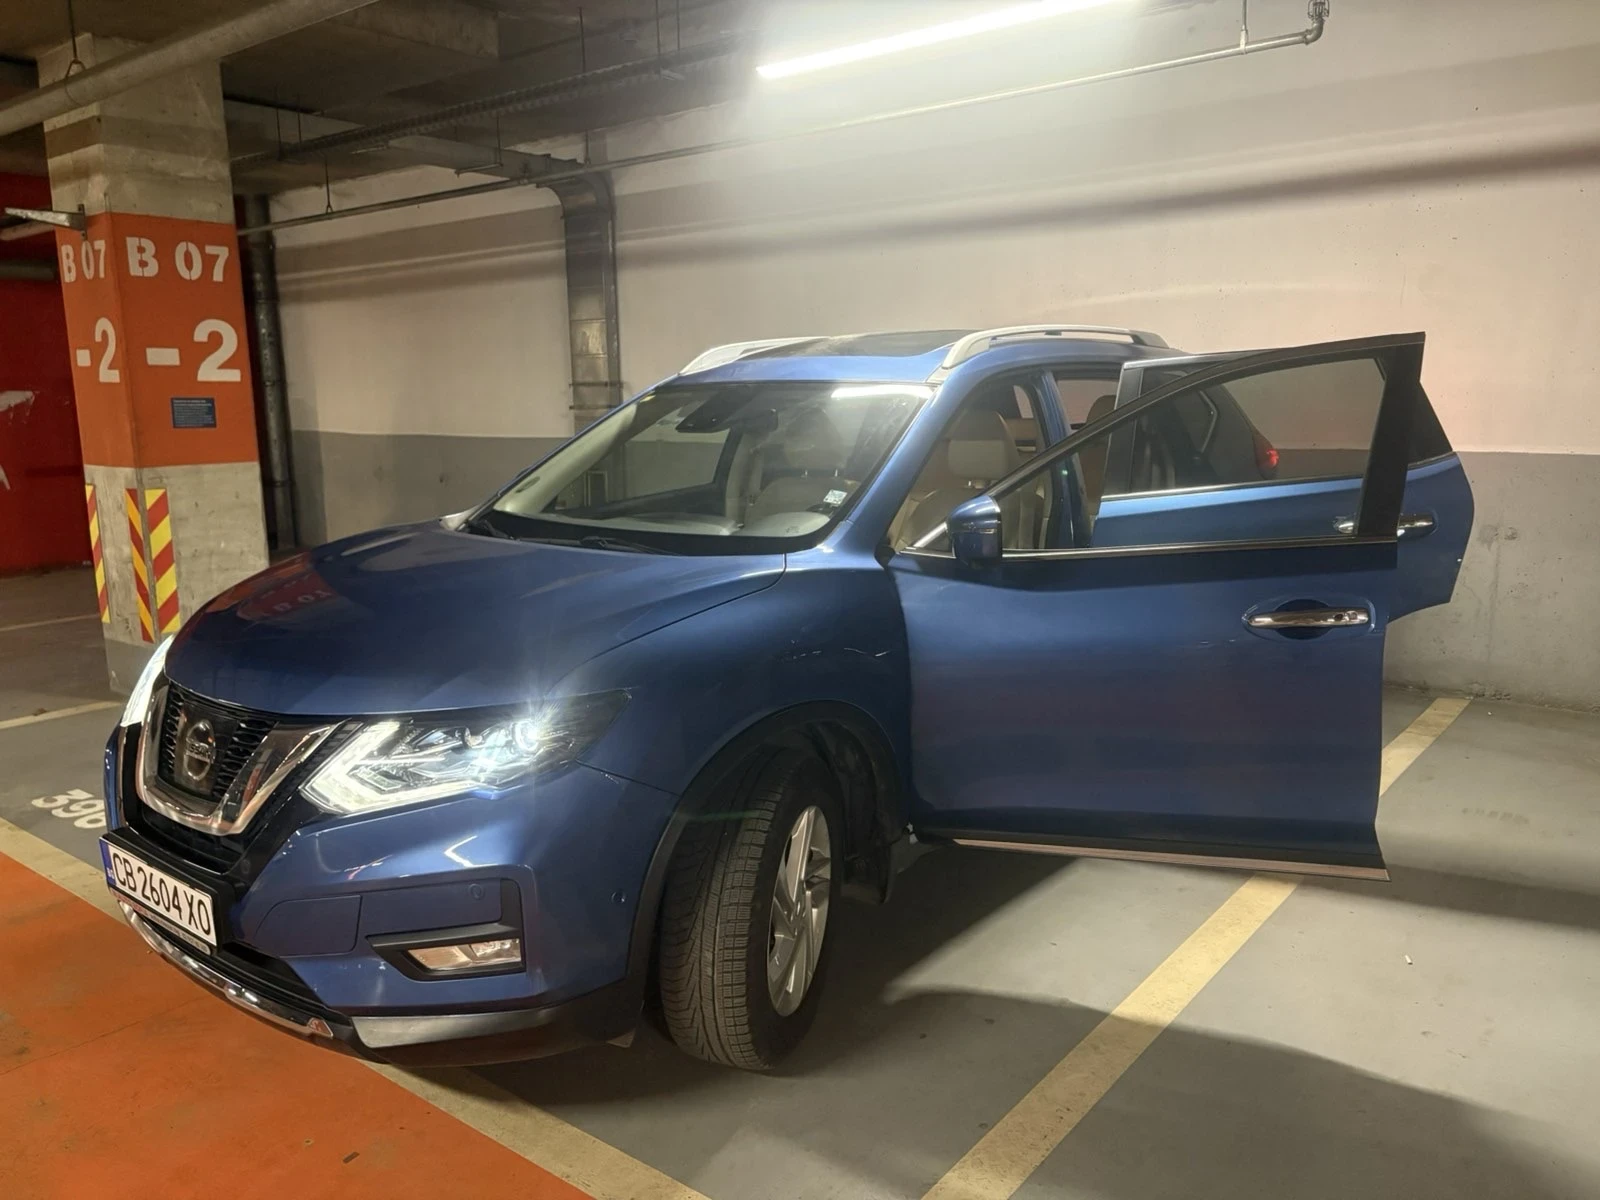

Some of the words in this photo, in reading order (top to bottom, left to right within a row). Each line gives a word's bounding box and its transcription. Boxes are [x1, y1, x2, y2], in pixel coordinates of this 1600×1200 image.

[61, 244, 76, 283] B
[81, 239, 106, 280] 07
[126, 237, 159, 277] B
[175, 241, 229, 282] 07
[76, 317, 120, 383] -2
[146, 319, 241, 382] -2
